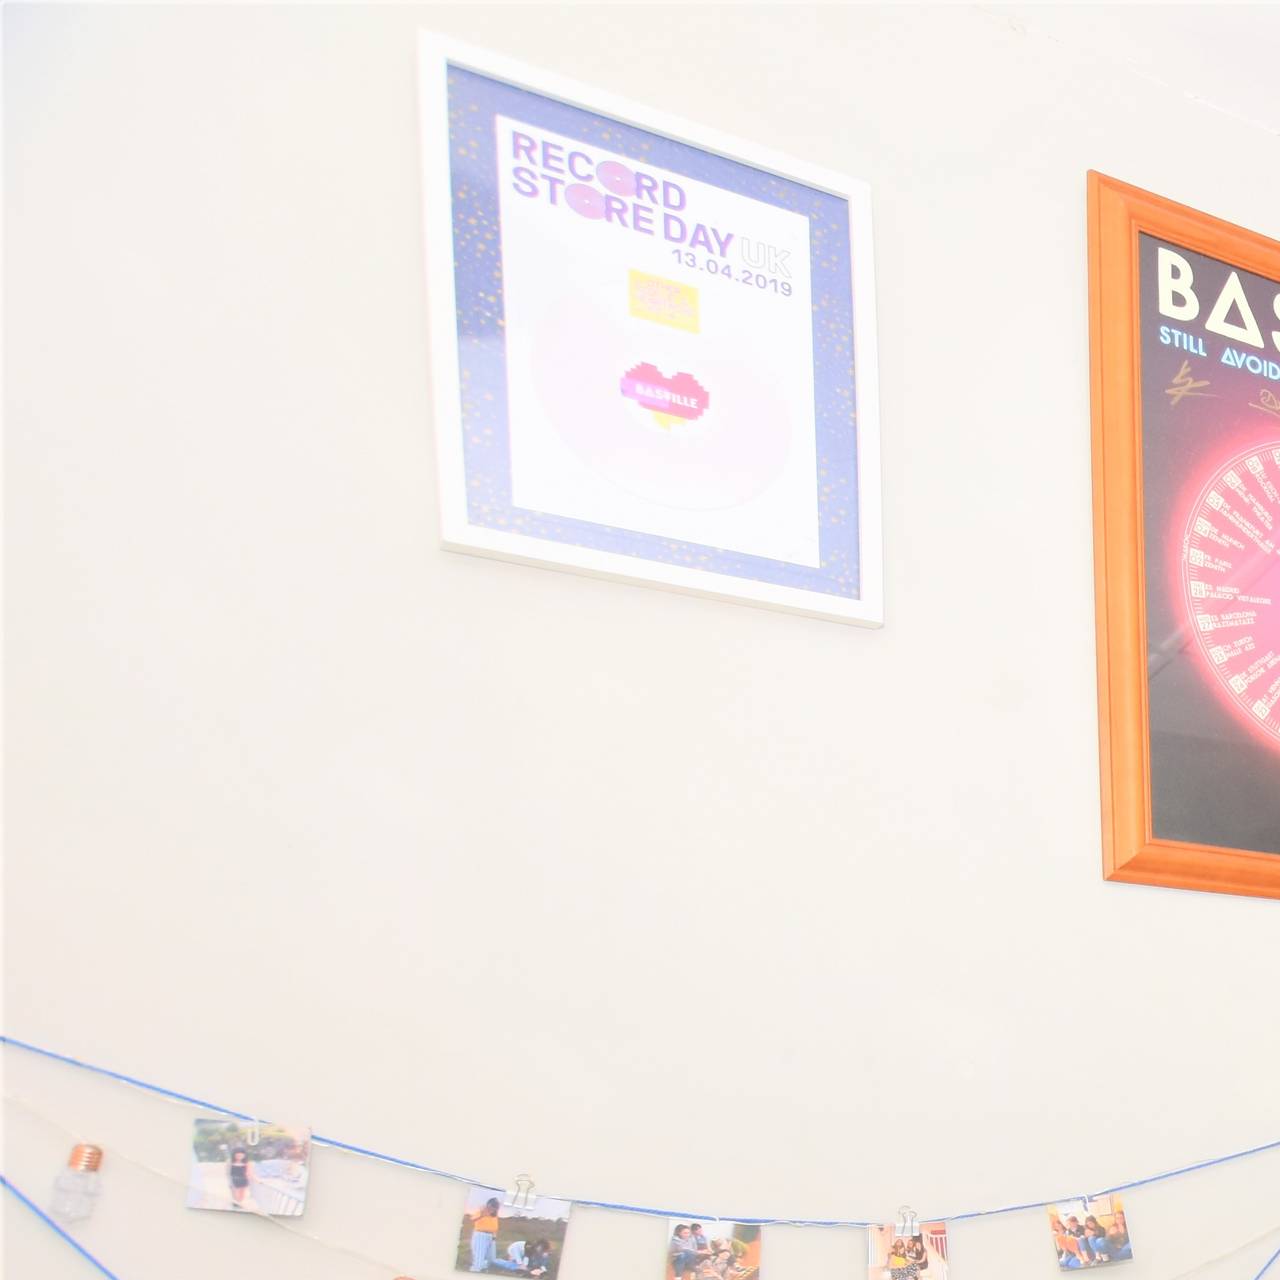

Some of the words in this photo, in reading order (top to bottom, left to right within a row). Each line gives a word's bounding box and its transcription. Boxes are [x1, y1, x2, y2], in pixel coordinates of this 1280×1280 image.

[512, 130, 687, 212] RECORD
[512, 166, 656, 235] STORE
[663, 211, 734, 258] DAY
[741, 237, 792, 278] UK
[672, 249, 793, 297] 13.04.2019
[1159, 326, 1207, 357] STILL
